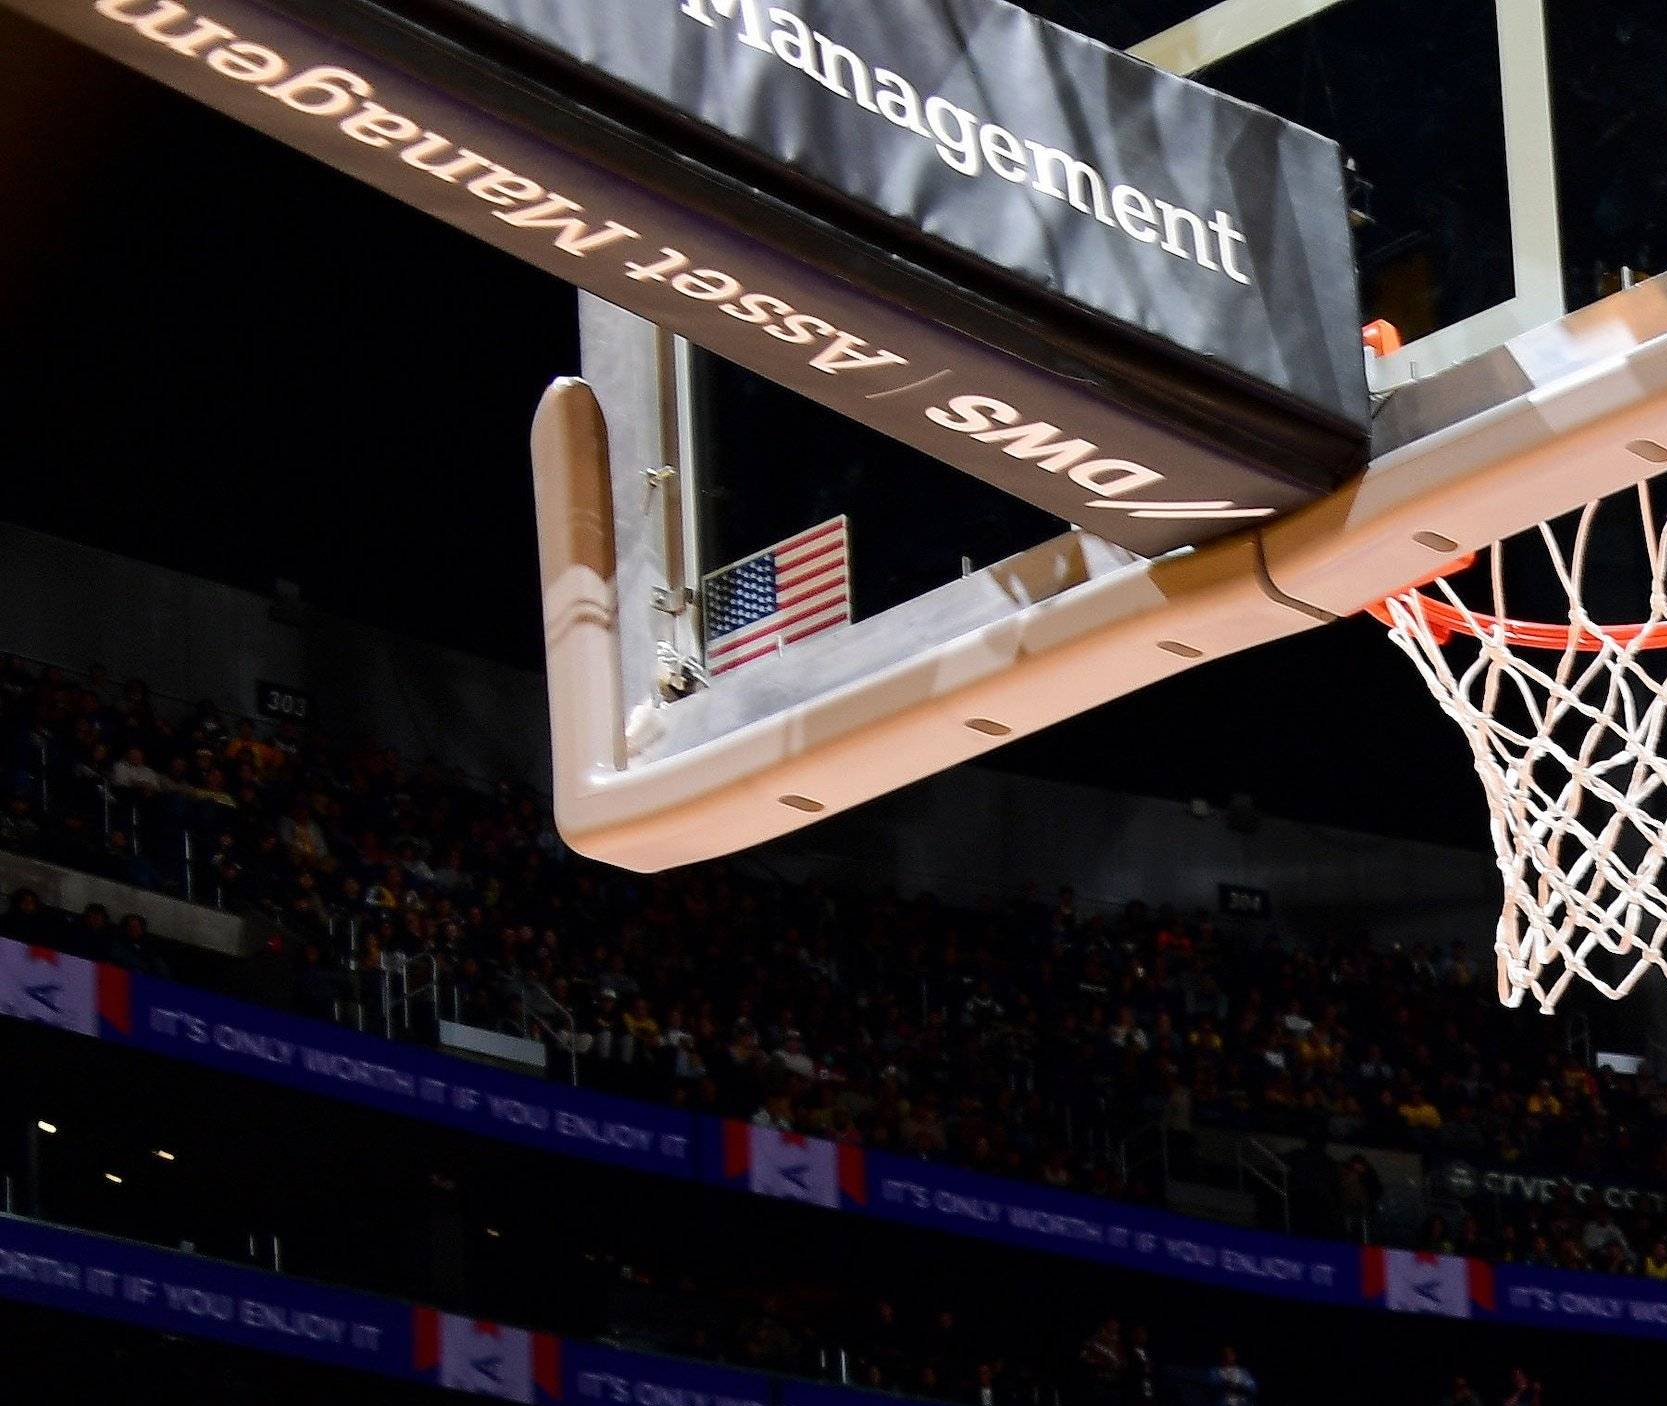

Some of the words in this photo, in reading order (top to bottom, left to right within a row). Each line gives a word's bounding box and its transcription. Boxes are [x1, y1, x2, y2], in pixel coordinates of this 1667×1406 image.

[681, 0, 1252, 286] Management
[625, 247, 909, 375] Asset
[924, 394, 1165, 499] DWS
